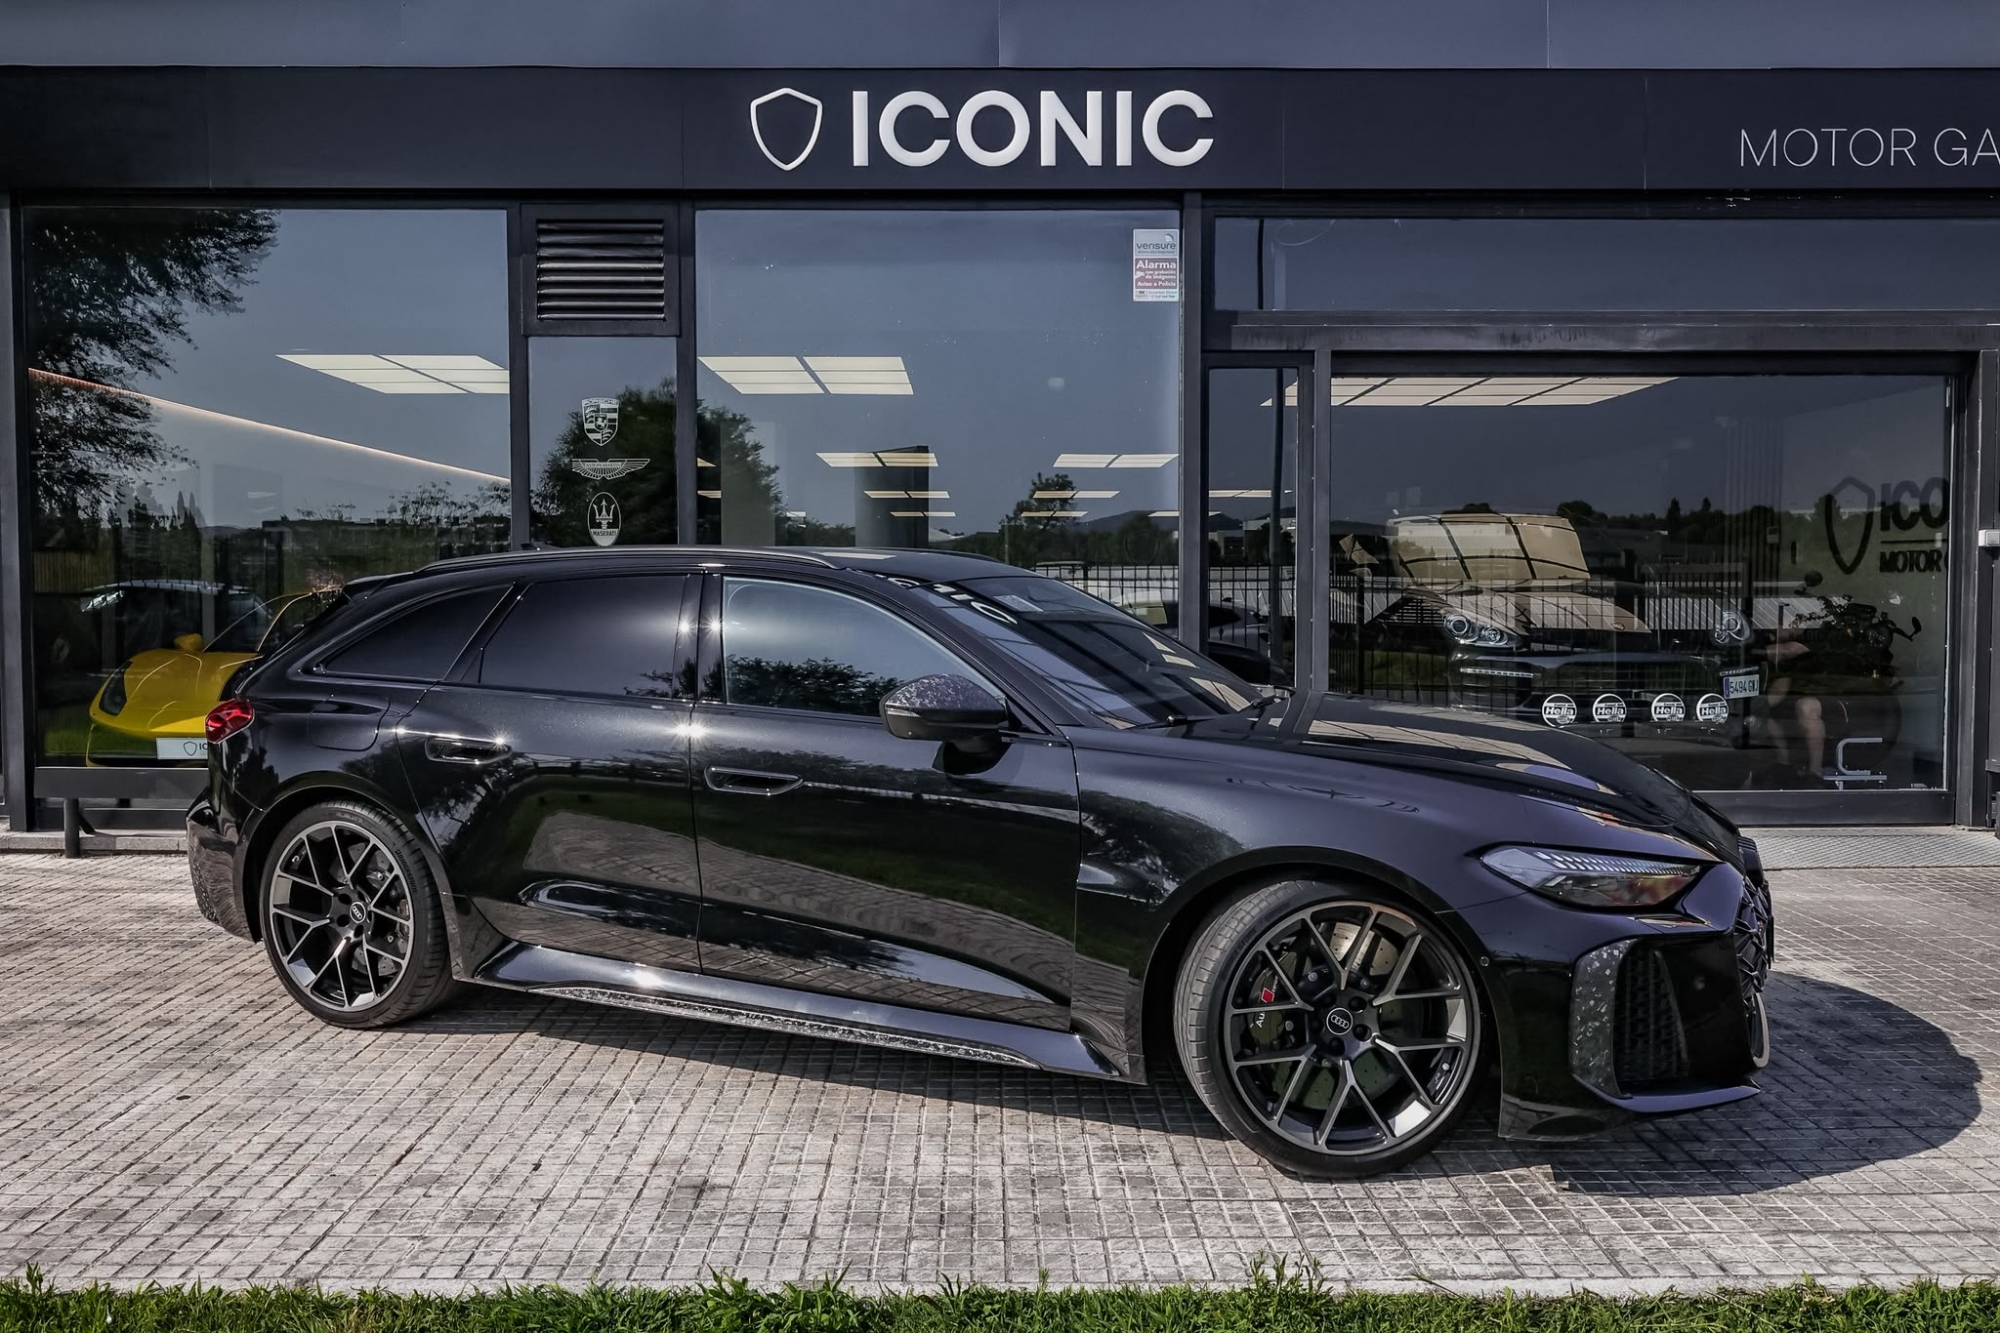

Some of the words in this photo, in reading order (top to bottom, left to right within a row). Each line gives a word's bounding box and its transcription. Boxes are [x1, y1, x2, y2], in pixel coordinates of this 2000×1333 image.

[851, 89, 1214, 168] ICONIC
[1740, 128, 1917, 167] MOTOR
[1933, 128, 2000, 167] GA
[1136, 242, 1176, 250] verisure
[1136, 260, 1176, 269] Alarma
[1880, 549, 1943, 573] MOTOR
[1729, 680, 1747, 694] 5494
[1545, 706, 1575, 715] Hella
[1596, 707, 1625, 715] Hella
[1655, 706, 1684, 715] Hella
[1701, 706, 1727, 716] Hella
